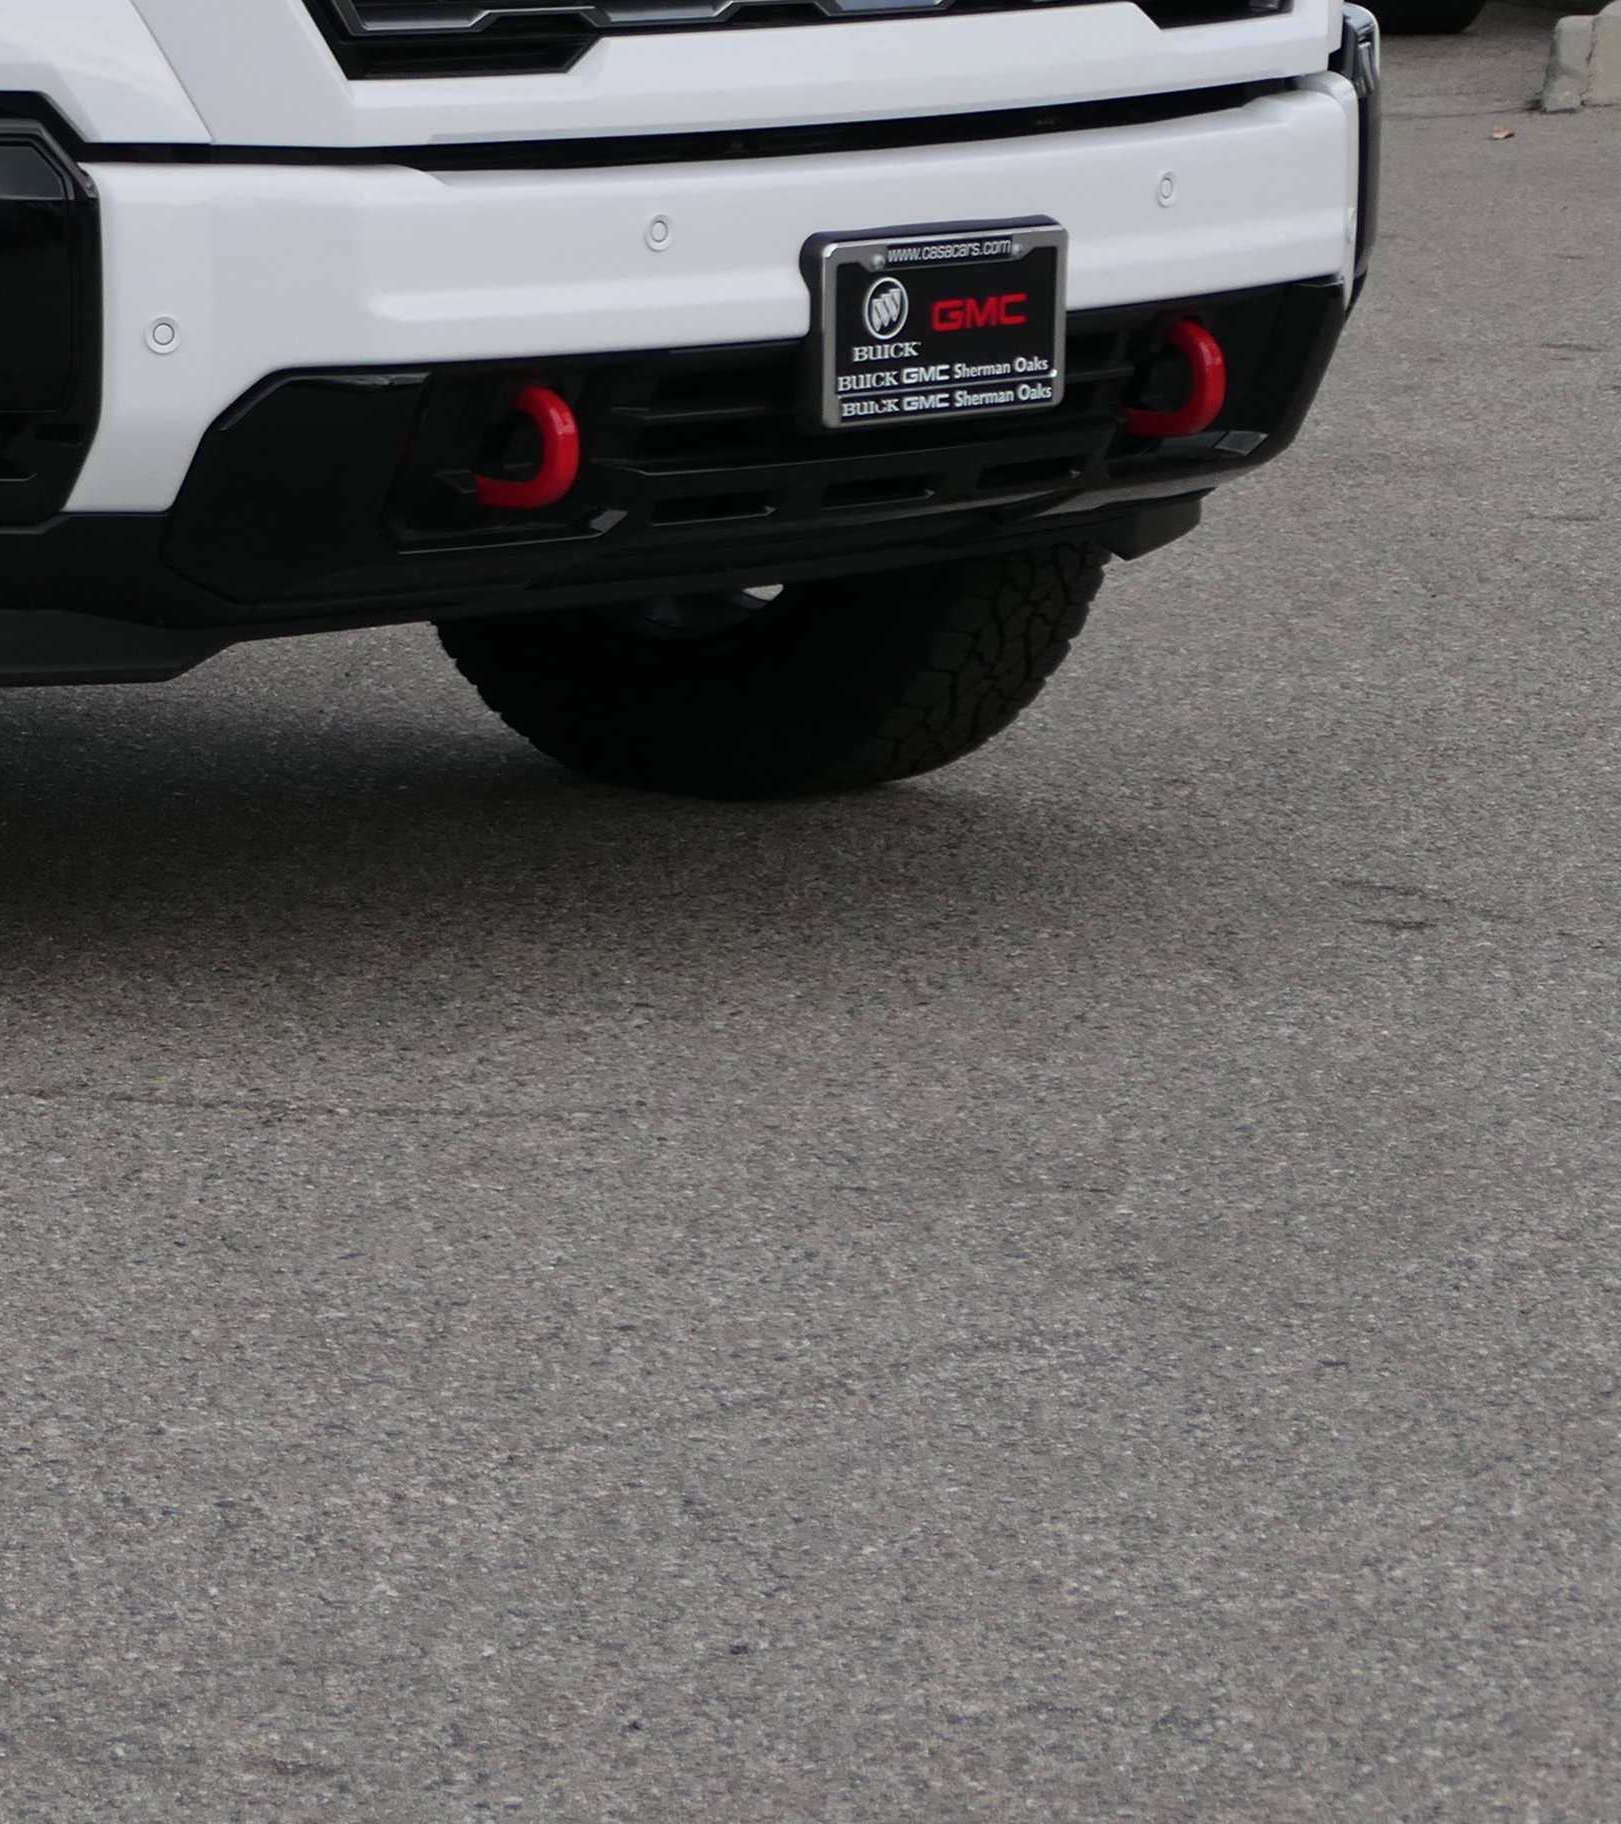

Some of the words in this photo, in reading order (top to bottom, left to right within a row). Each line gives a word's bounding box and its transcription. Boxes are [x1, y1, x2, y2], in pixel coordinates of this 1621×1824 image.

[887, 238, 1011, 262] www.casacars.com
[929, 292, 1028, 332] GMC
[852, 341, 920, 362] BUICK
[837, 371, 899, 392] BUICK
[902, 364, 950, 385] GMC
[953, 358, 1011, 380] Sherman
[1014, 355, 1049, 374] Oaks
[841, 397, 900, 417] BUICK
[903, 395, 950, 412] GMC
[954, 387, 1015, 408] Sherman
[1018, 384, 1052, 402] Oaks
